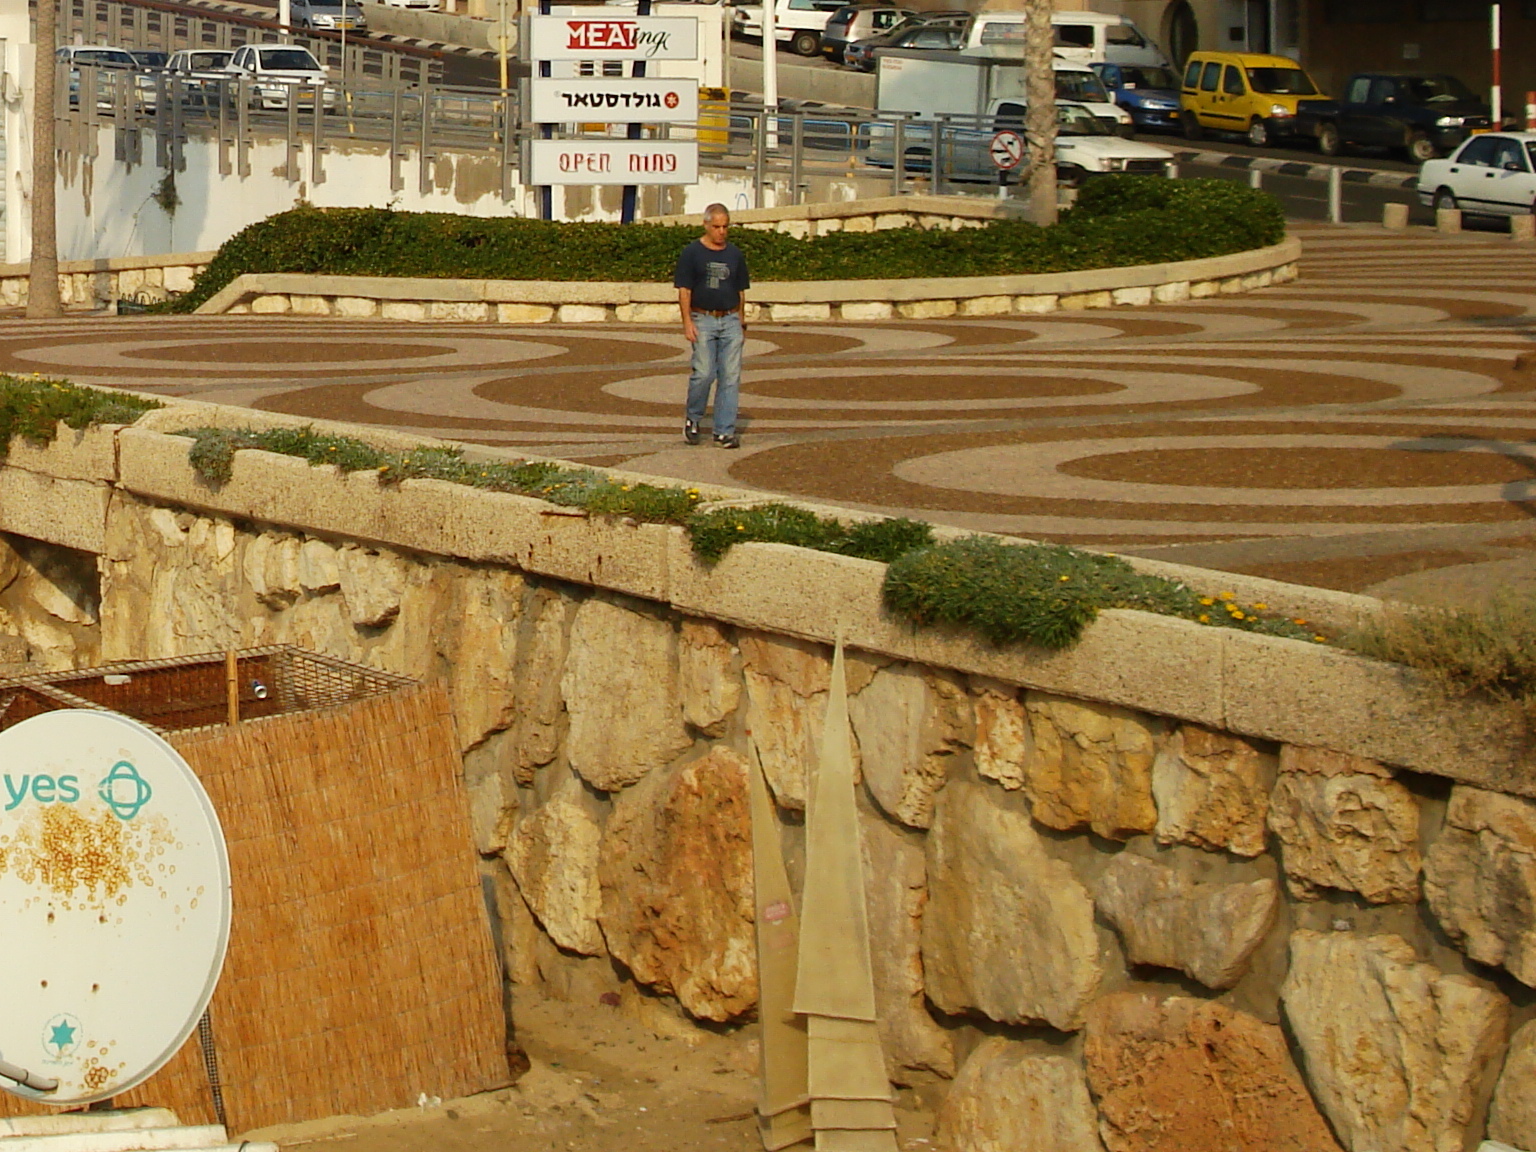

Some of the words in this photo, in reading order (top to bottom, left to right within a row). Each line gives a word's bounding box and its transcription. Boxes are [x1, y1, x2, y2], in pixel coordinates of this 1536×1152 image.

[561, 92, 661, 108] גולדסטאר
[559, 153, 611, 173] OPEN
[629, 153, 677, 173] פתוח
[3, 772, 81, 811] yes
